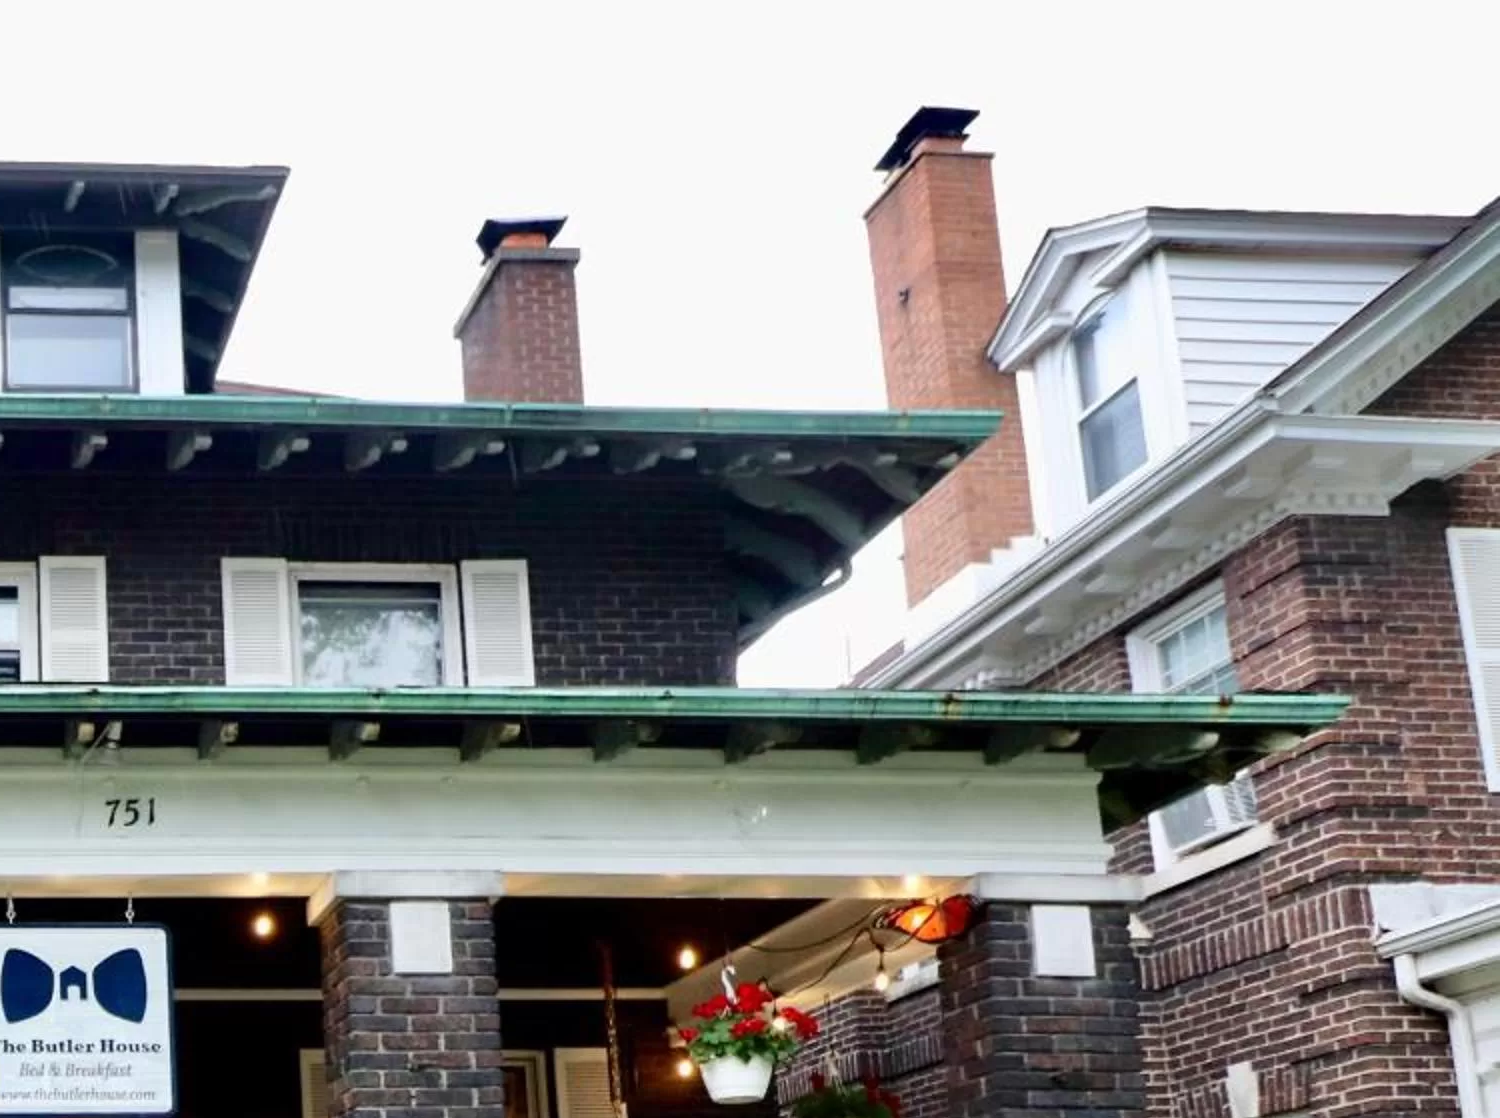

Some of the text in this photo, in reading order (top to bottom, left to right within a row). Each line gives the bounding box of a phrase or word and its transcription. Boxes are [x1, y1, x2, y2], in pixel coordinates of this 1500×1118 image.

[105, 797, 155, 827] 751
[31, 1038, 95, 1054] Butler
[100, 1038, 162, 1054] House
[20, 1062, 132, 1080] Bed & Breakfast
